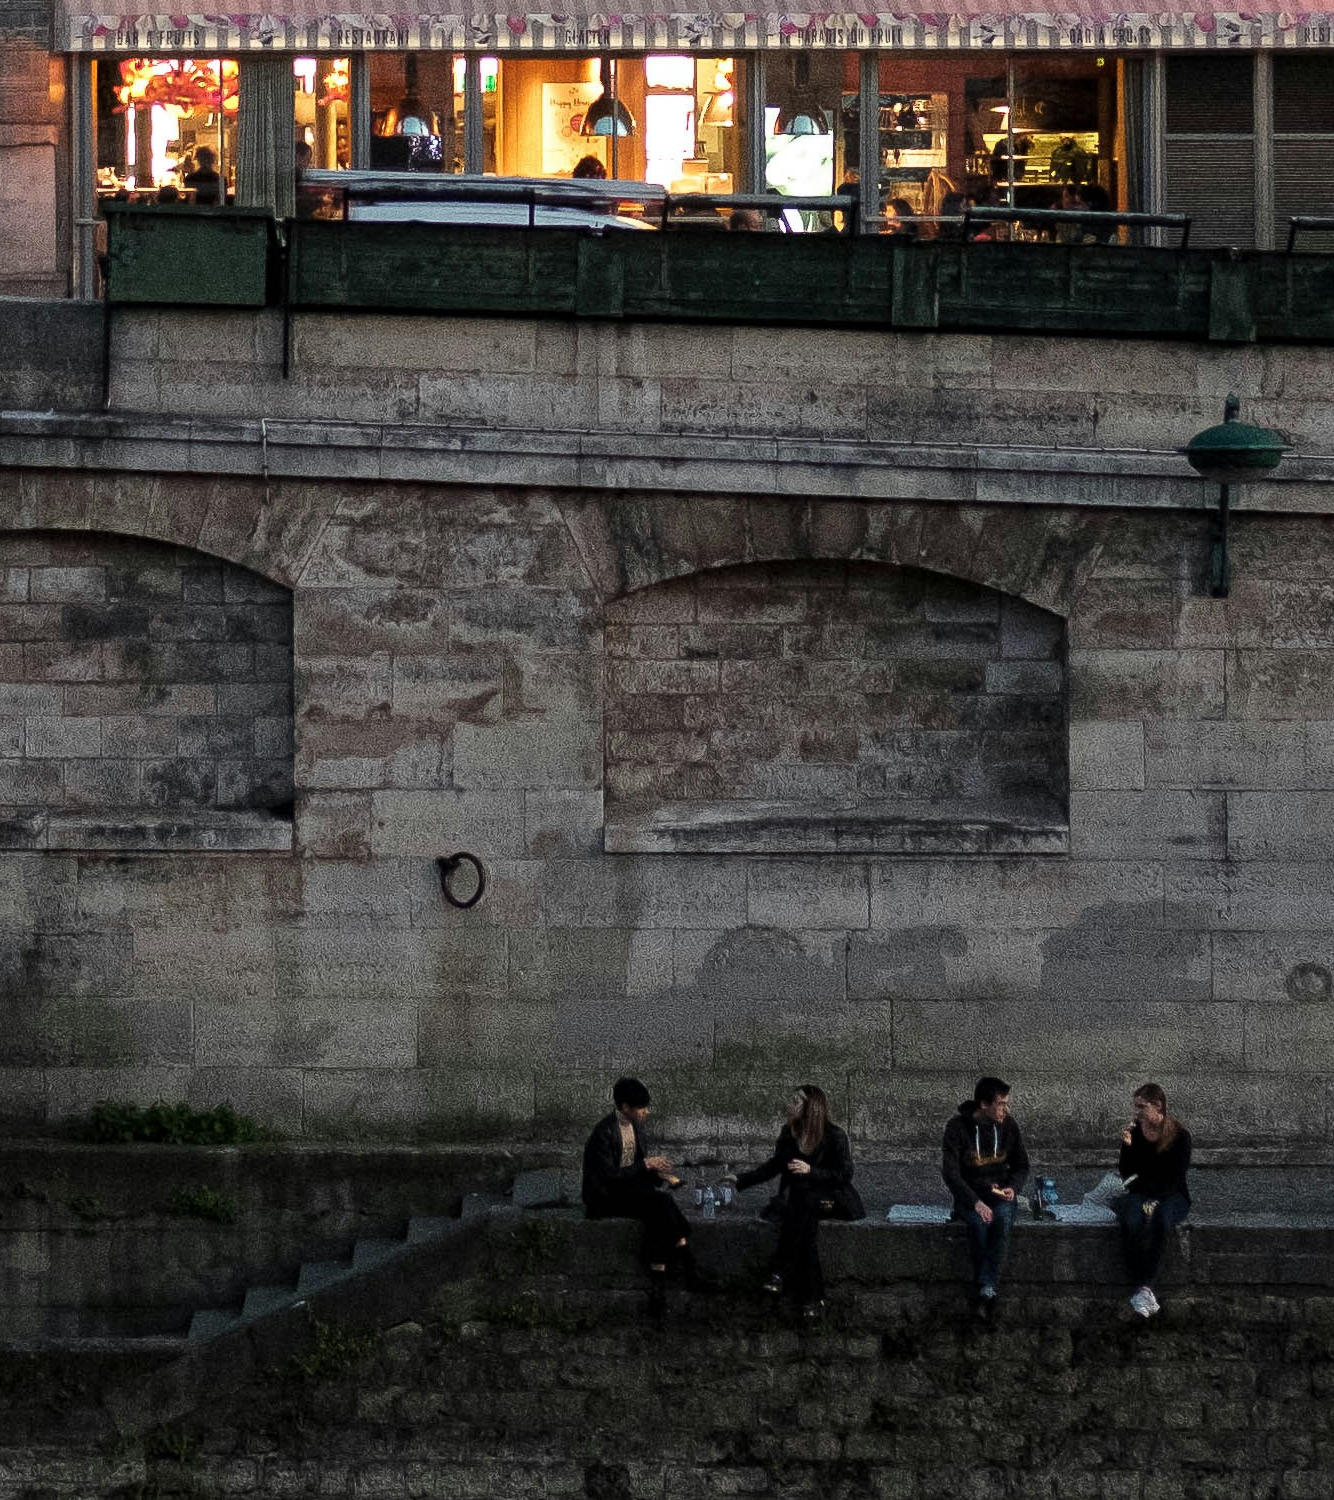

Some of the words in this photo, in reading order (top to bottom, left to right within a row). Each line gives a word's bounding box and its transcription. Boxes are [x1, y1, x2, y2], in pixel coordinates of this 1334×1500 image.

[116, 29, 139, 45] BAR
[159, 29, 200, 45] FRUITS
[337, 29, 410, 45] RESTAURANT
[564, 29, 610, 45] GLACIER
[798, 29, 844, 45] PARADIS
[850, 29, 865, 45] DU
[870, 29, 903, 45] FRUIT
[1069, 27, 1092, 44] BAR
[1112, 27, 1151, 44] FRUITS
